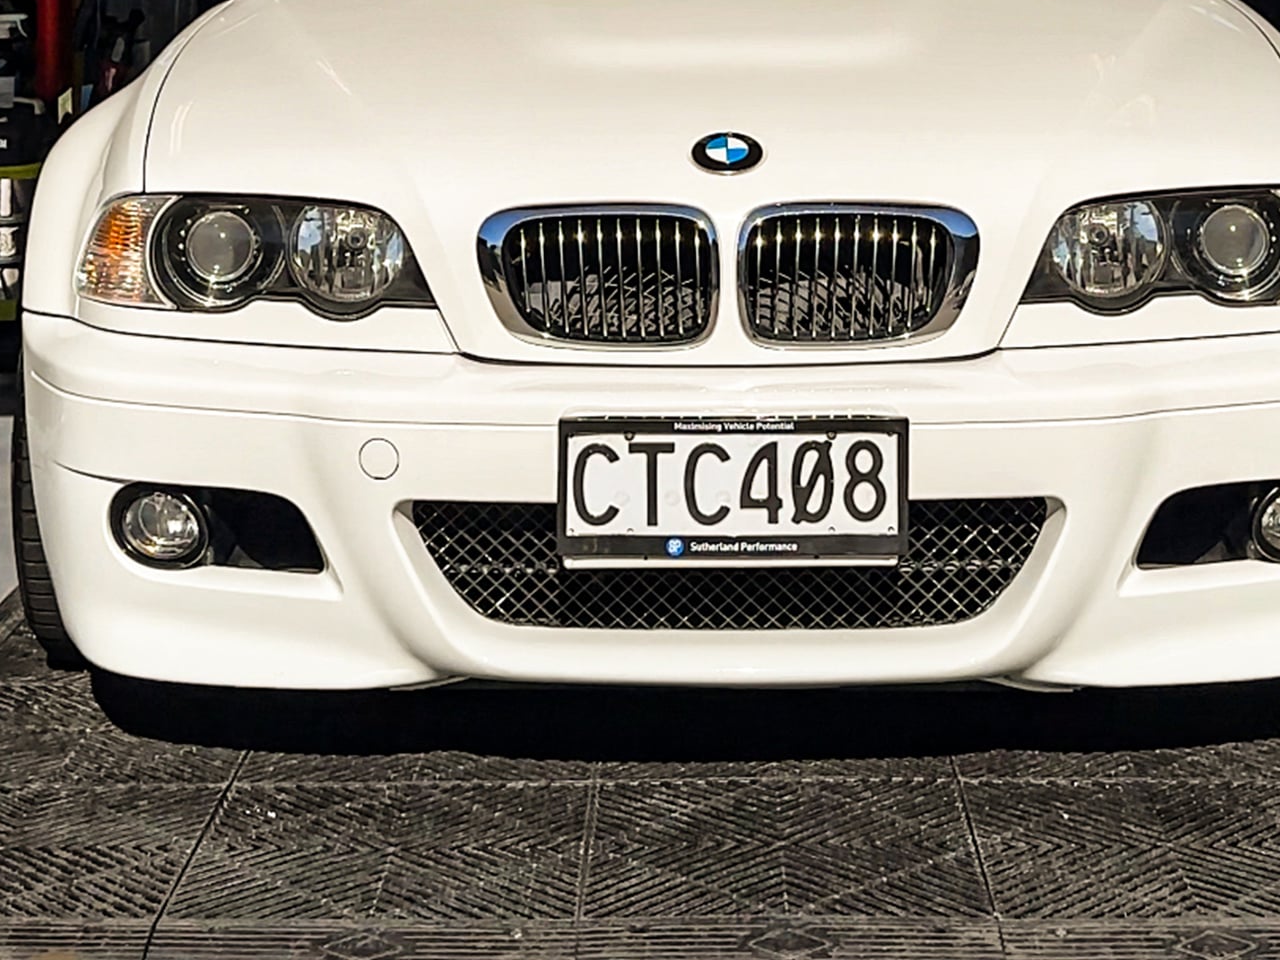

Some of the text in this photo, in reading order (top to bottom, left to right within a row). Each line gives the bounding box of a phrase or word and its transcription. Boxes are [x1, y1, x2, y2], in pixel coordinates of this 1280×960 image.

[673, 421, 795, 432] Maximising Vehicle Potential
[572, 439, 888, 527] CTC408
[690, 541, 739, 552] Sutherland
[740, 541, 798, 552] Performance
